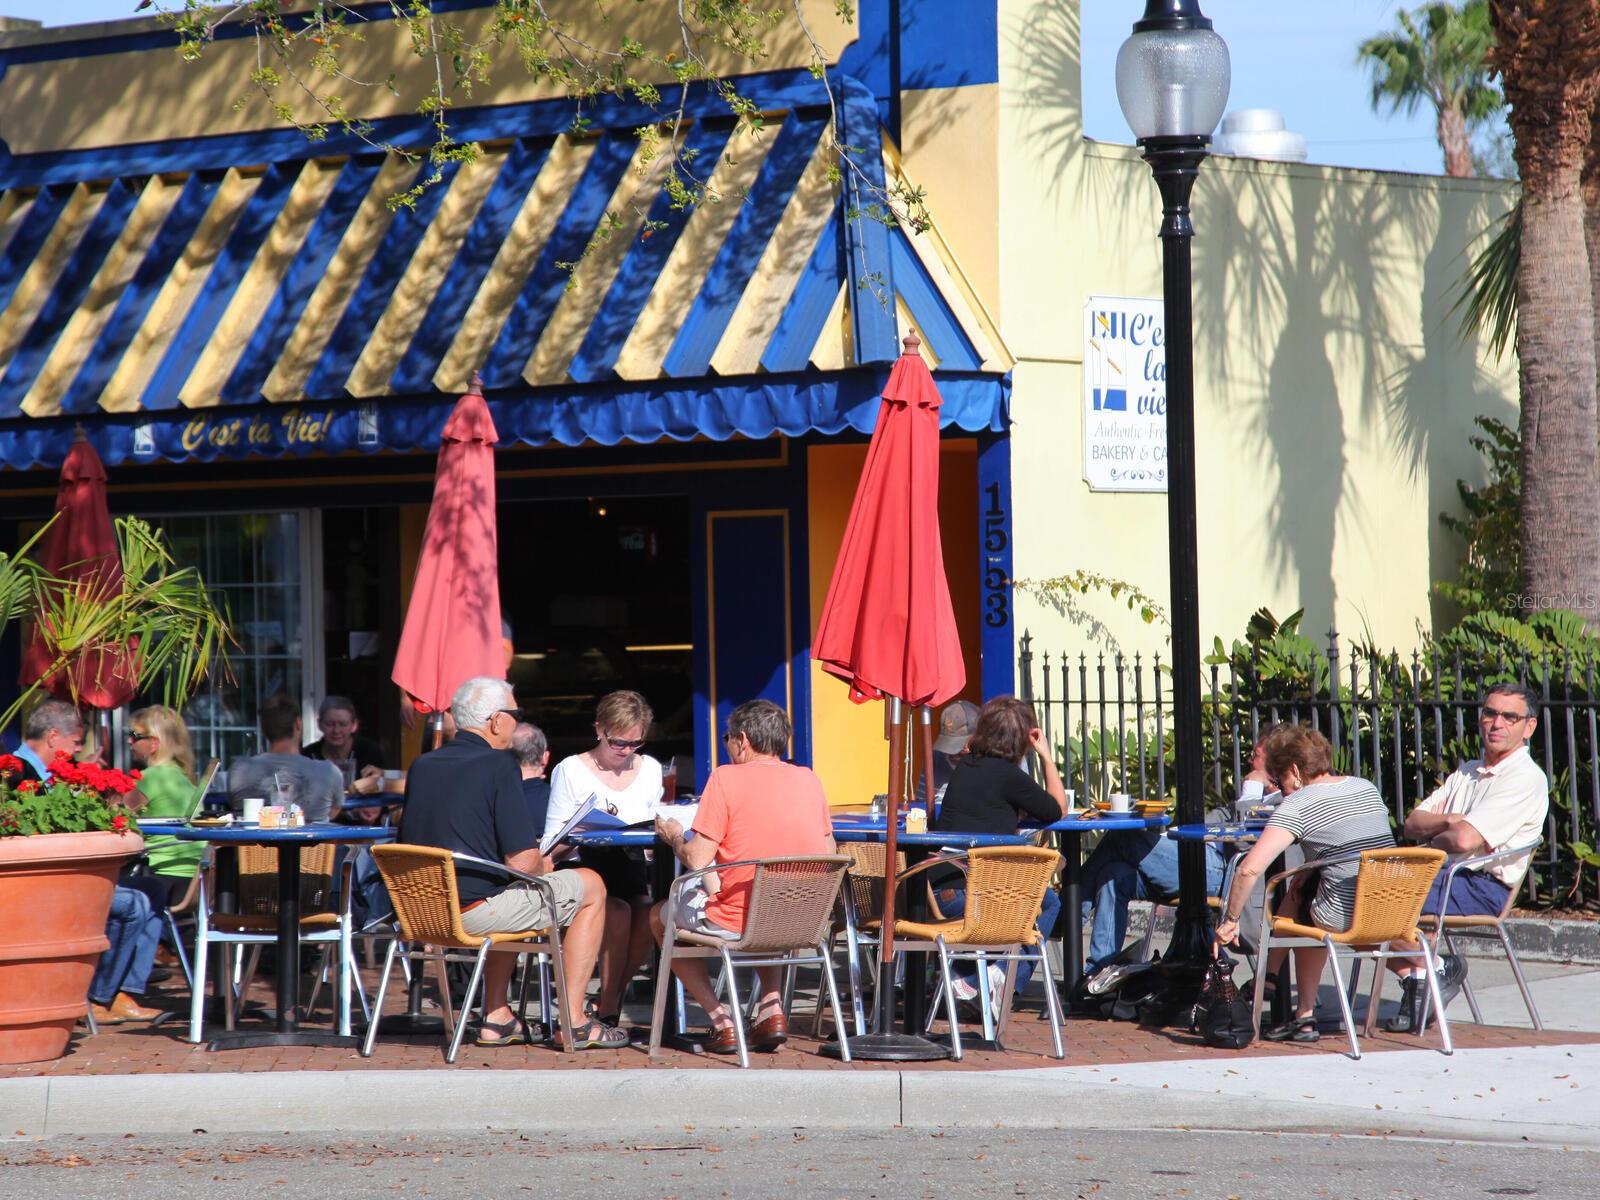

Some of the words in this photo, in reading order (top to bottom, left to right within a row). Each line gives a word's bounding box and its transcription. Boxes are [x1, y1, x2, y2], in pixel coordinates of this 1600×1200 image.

[1130, 313, 1166, 346] C'e
[1144, 349, 1167, 381] la
[1137, 387, 1167, 415] vie
[182, 412, 241, 451] C'est
[248, 414, 273, 445] la
[281, 408, 334, 445] Vie!
[1094, 421, 1141, 440] Authentic
[1149, 422, 1167, 440] Fre
[1092, 445, 1136, 461] BAKERY
[1153, 446, 1168, 462] CA
[985, 481, 1008, 628] 1553
